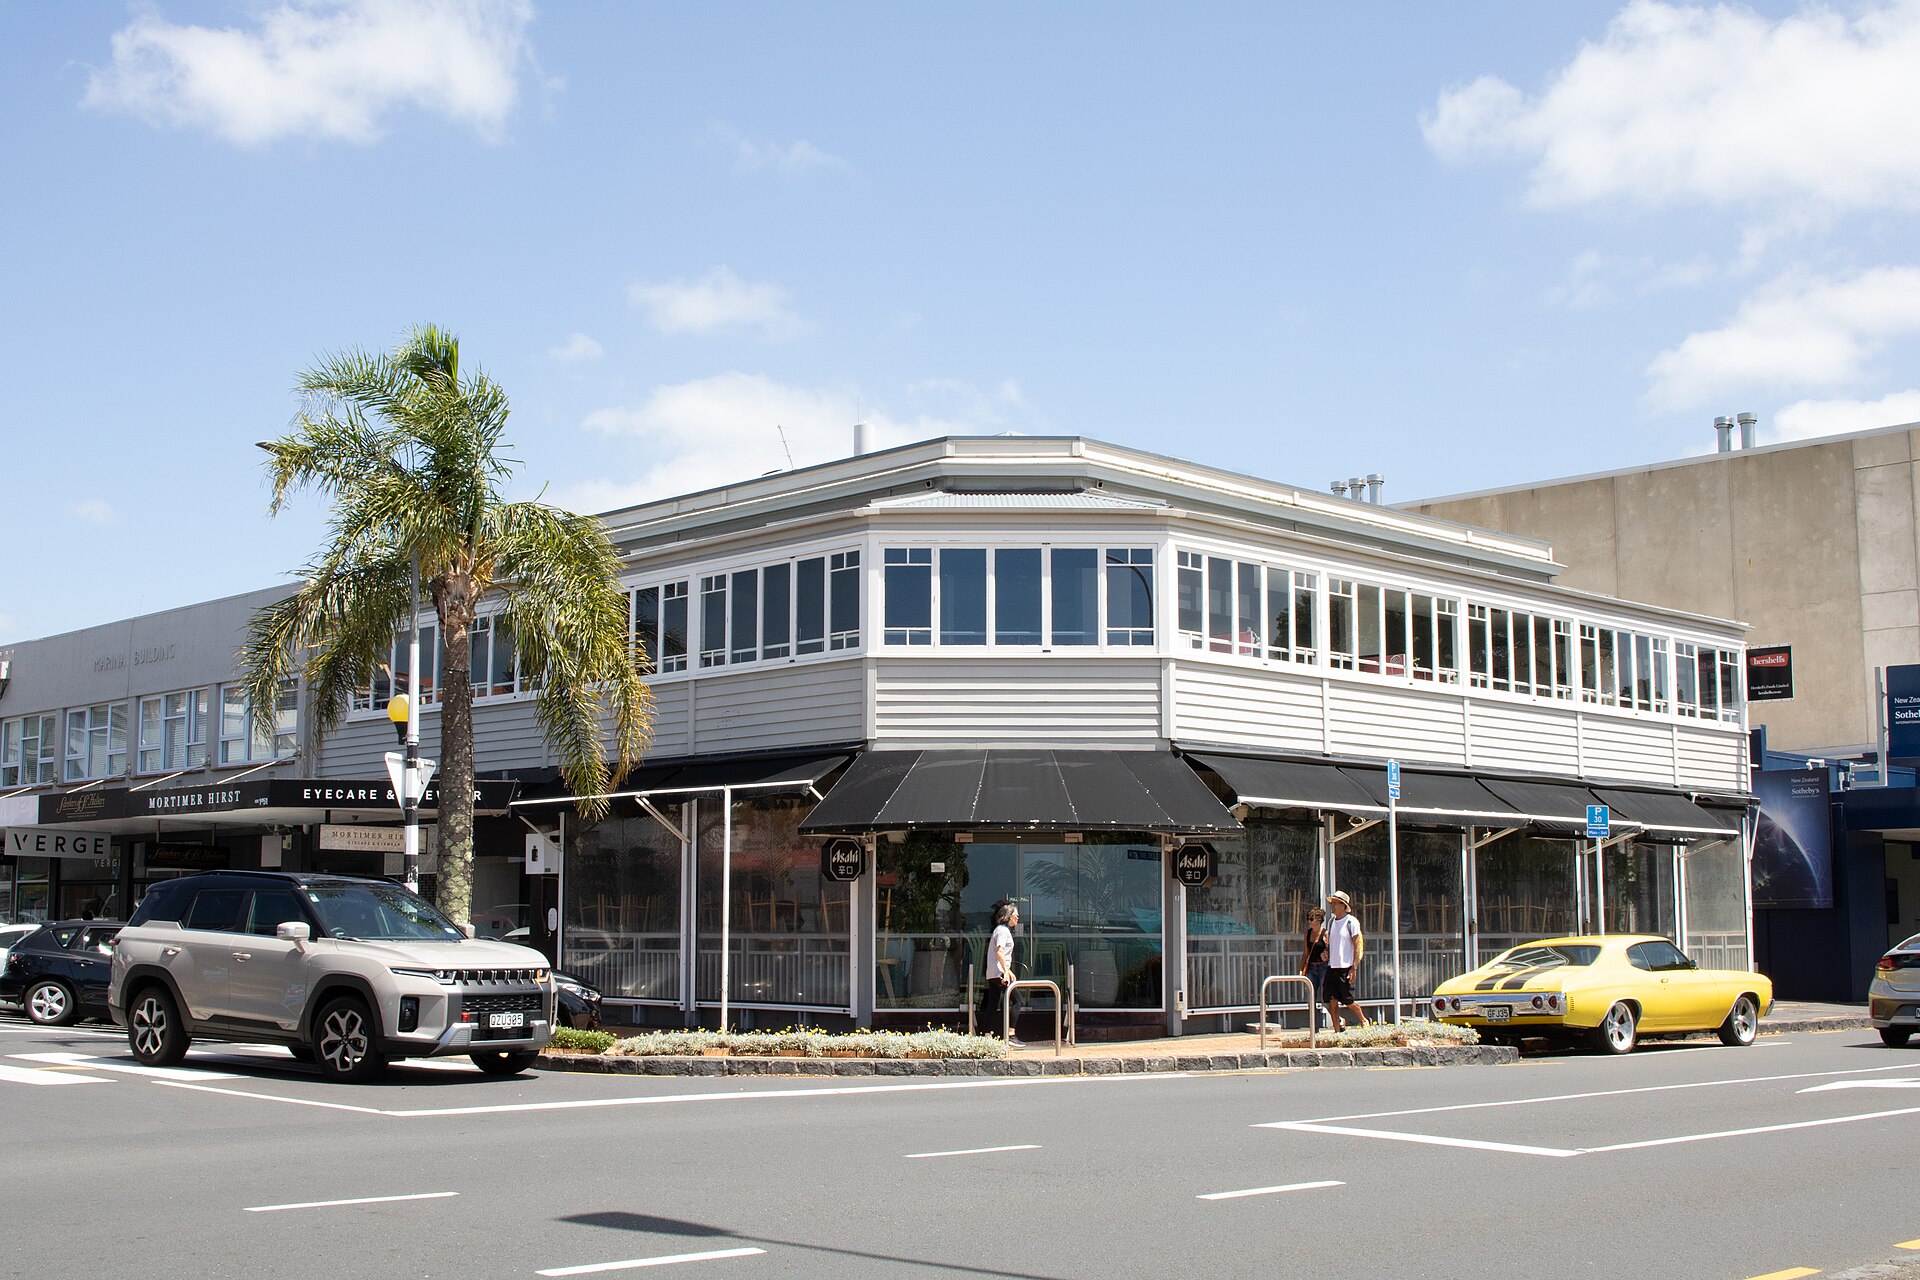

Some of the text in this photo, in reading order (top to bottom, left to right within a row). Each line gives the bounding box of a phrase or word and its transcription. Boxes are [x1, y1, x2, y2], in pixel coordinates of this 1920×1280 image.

[134, 644, 176, 666] BUILDING
[148, 790, 240, 809] MORTIMER HIRST
[303, 789, 396, 800] EYECARE &
[1594, 807, 1602, 815] P
[332, 831, 404, 841] MORTIMER HIR
[14, 834, 104, 854] VERGE
[832, 849, 859, 863] Asahi
[1180, 854, 1206, 868] Asahi
[94, 859, 121, 867] VERG
[838, 865, 853, 875] 辛口
[1185, 870, 1200, 880] 辛口
[491, 1015, 522, 1025] QZU305
